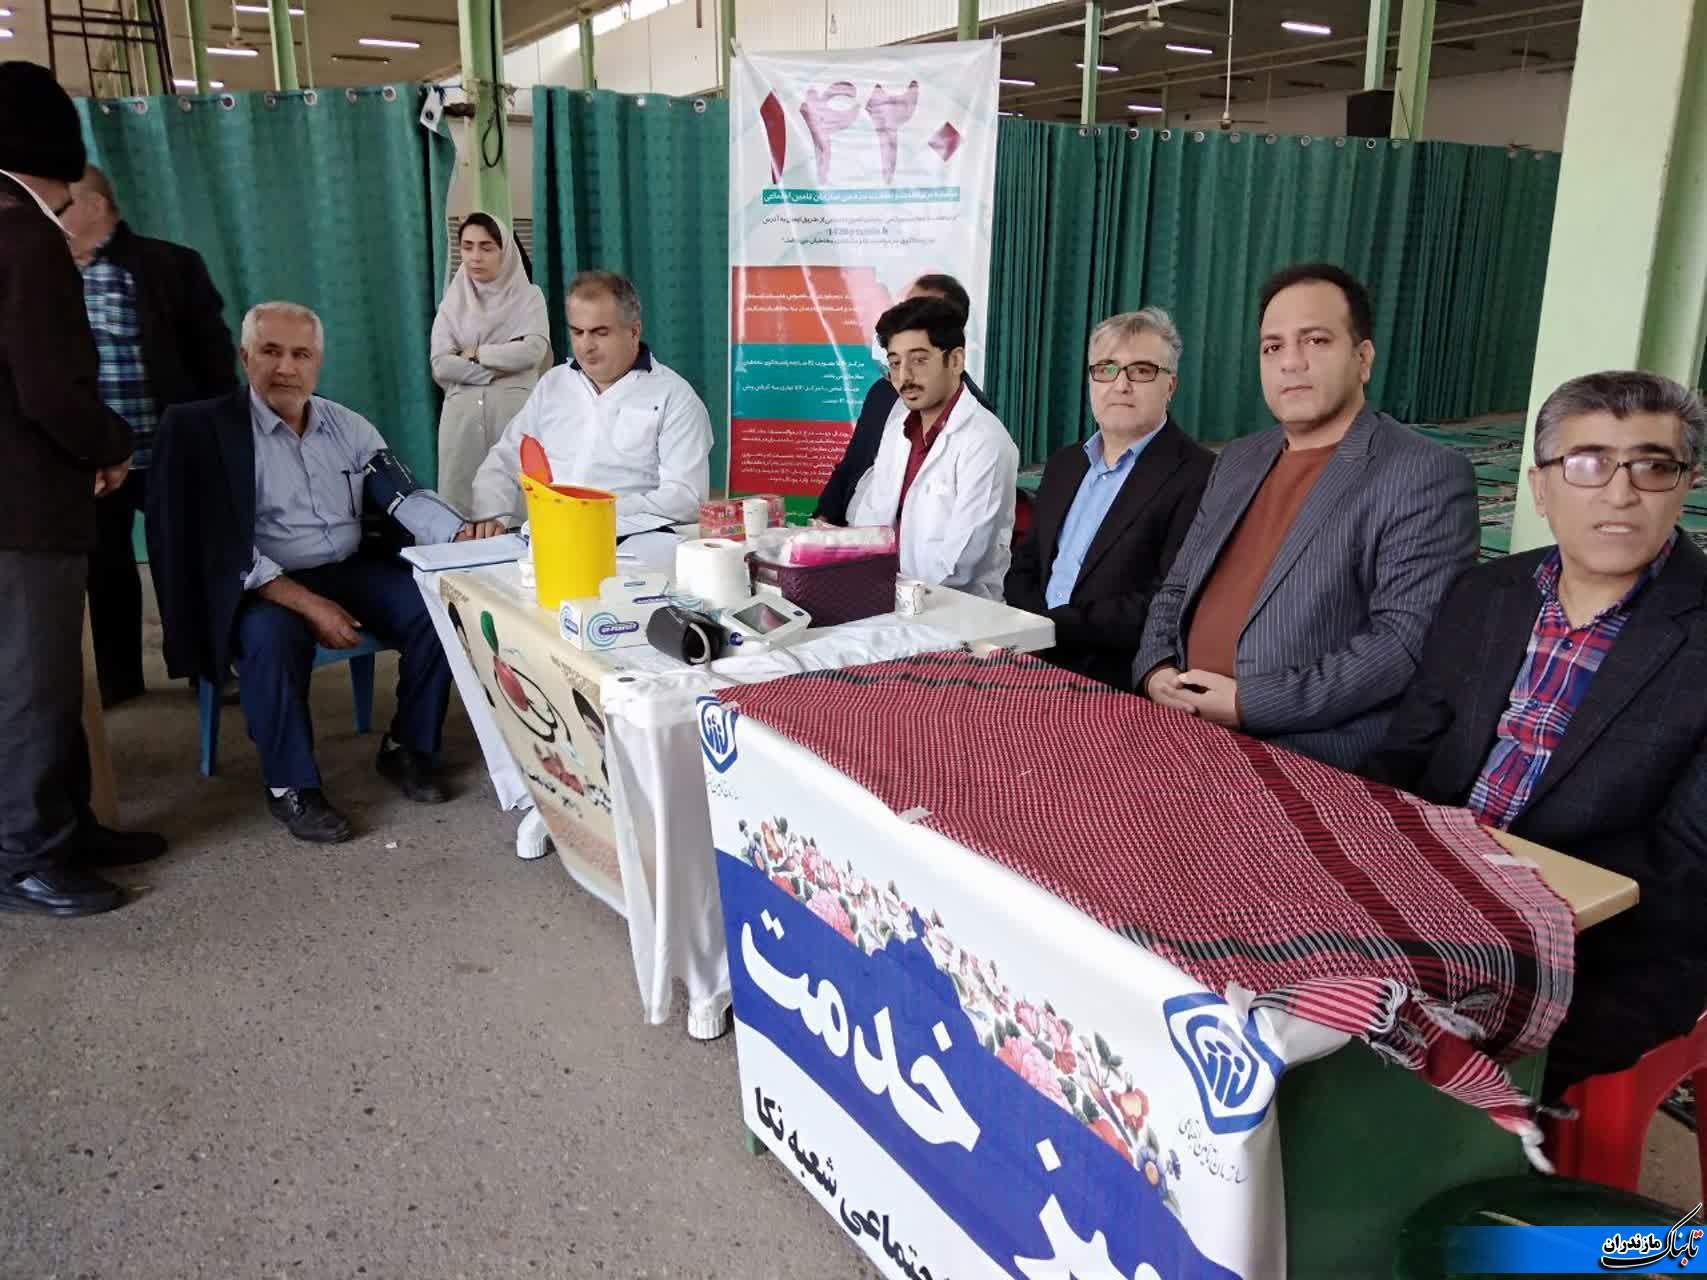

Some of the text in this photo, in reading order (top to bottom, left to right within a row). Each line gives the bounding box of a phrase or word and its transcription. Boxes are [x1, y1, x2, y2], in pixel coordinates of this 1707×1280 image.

[741, 909, 981, 1152] خدمت
[755, 1087, 784, 1141] نکا
[788, 1130, 838, 1198] شعبه
